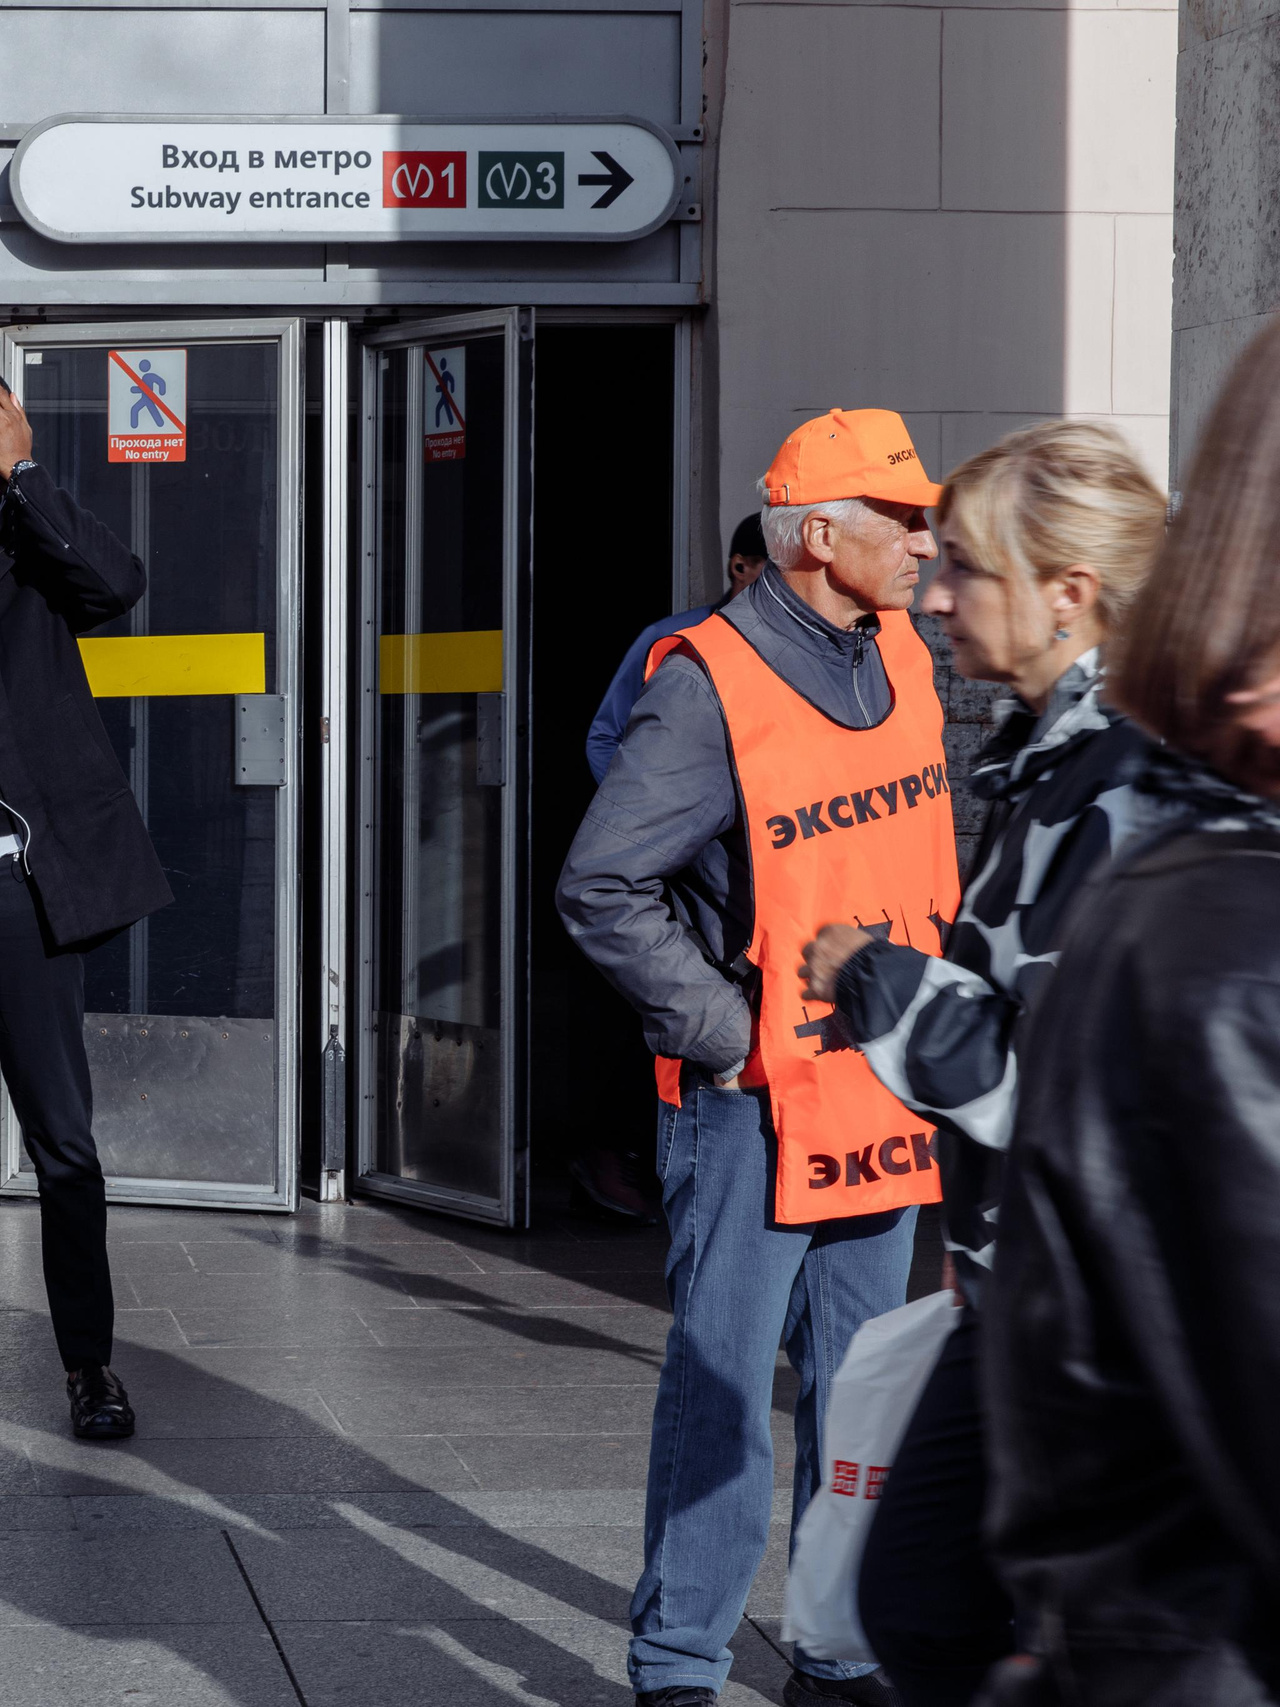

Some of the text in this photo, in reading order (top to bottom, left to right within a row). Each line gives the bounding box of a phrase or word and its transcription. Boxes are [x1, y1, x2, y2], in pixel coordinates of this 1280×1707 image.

[162, 144, 372, 175] Вход в метро
[130, 185, 371, 214] Subway entrance
[110, 437, 185, 451] Прохода нет
[425, 435, 465, 450] Прохода нет
[125, 449, 170, 461] No entry
[432, 449, 457, 459] No entry
[765, 762, 949, 850] ЭКСКУРСИ
